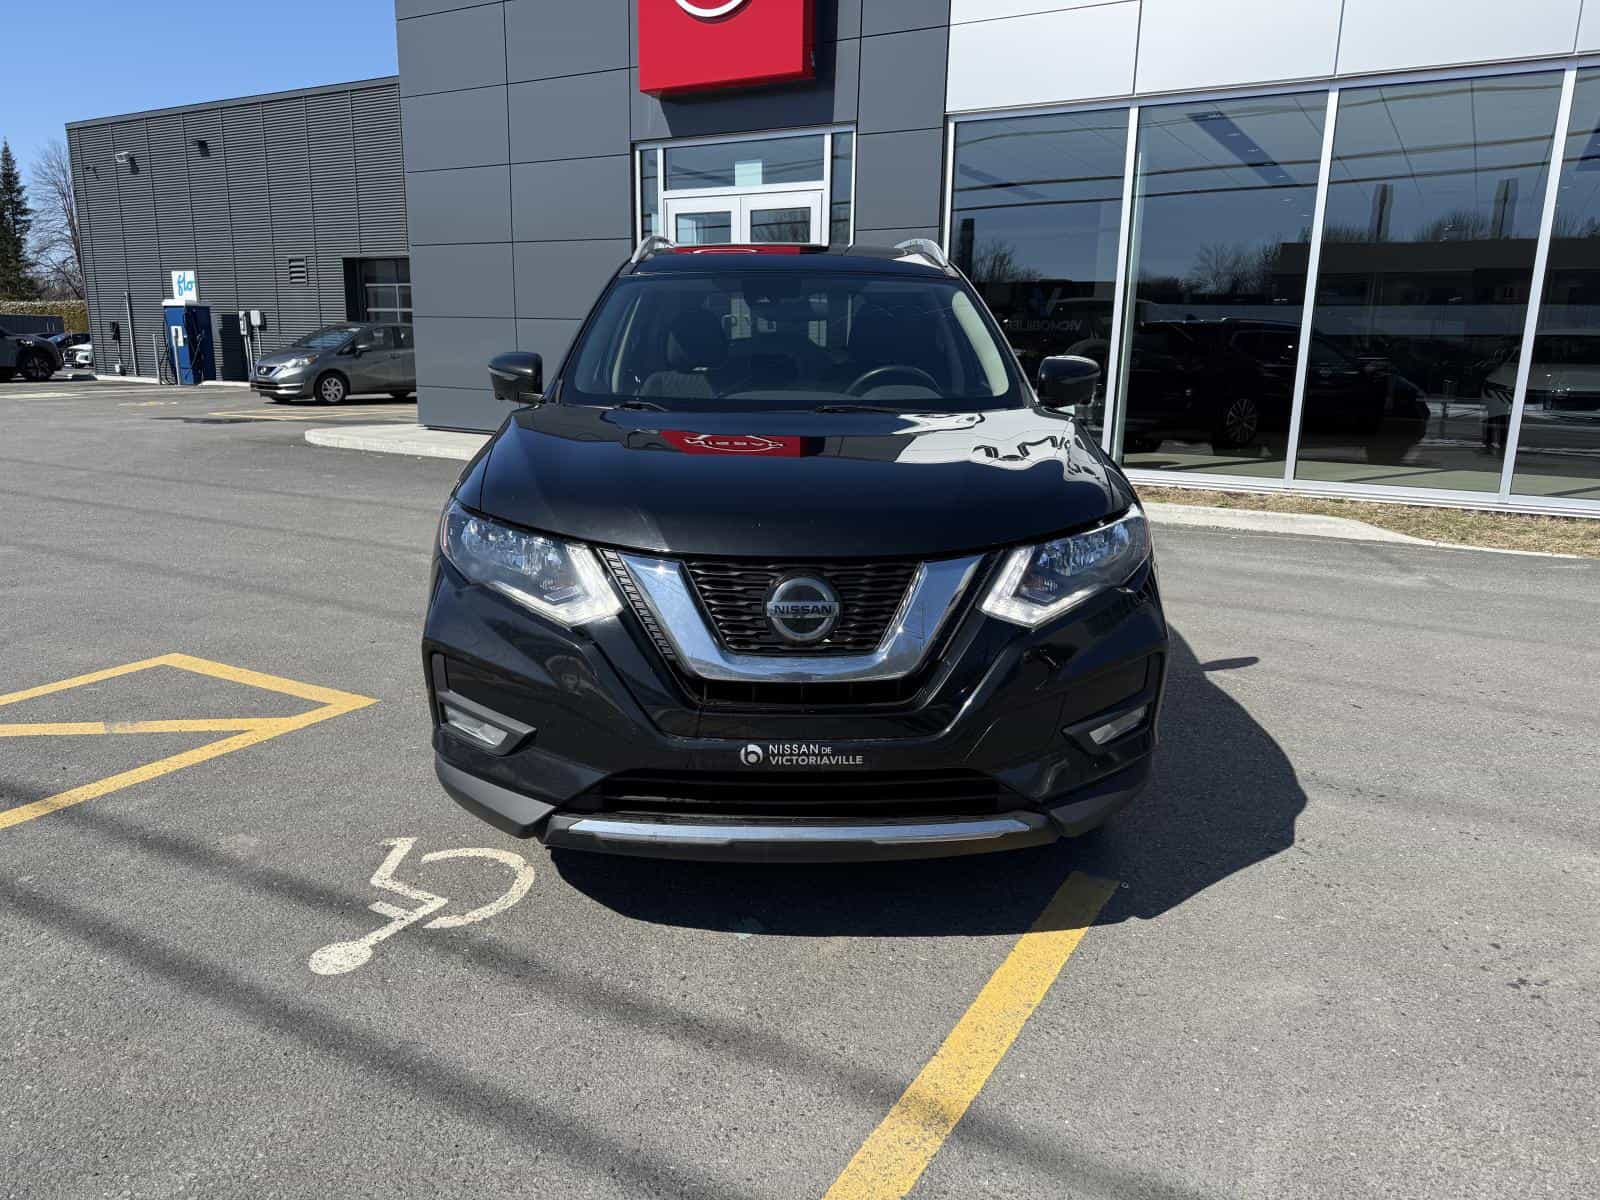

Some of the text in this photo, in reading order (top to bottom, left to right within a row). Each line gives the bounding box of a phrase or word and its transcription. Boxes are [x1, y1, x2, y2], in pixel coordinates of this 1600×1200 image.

[177, 271, 196, 297] flo
[773, 604, 832, 615] NISSAN
[768, 743, 833, 754] NISSAN DE
[769, 755, 864, 765] VICTORIAVILLE
